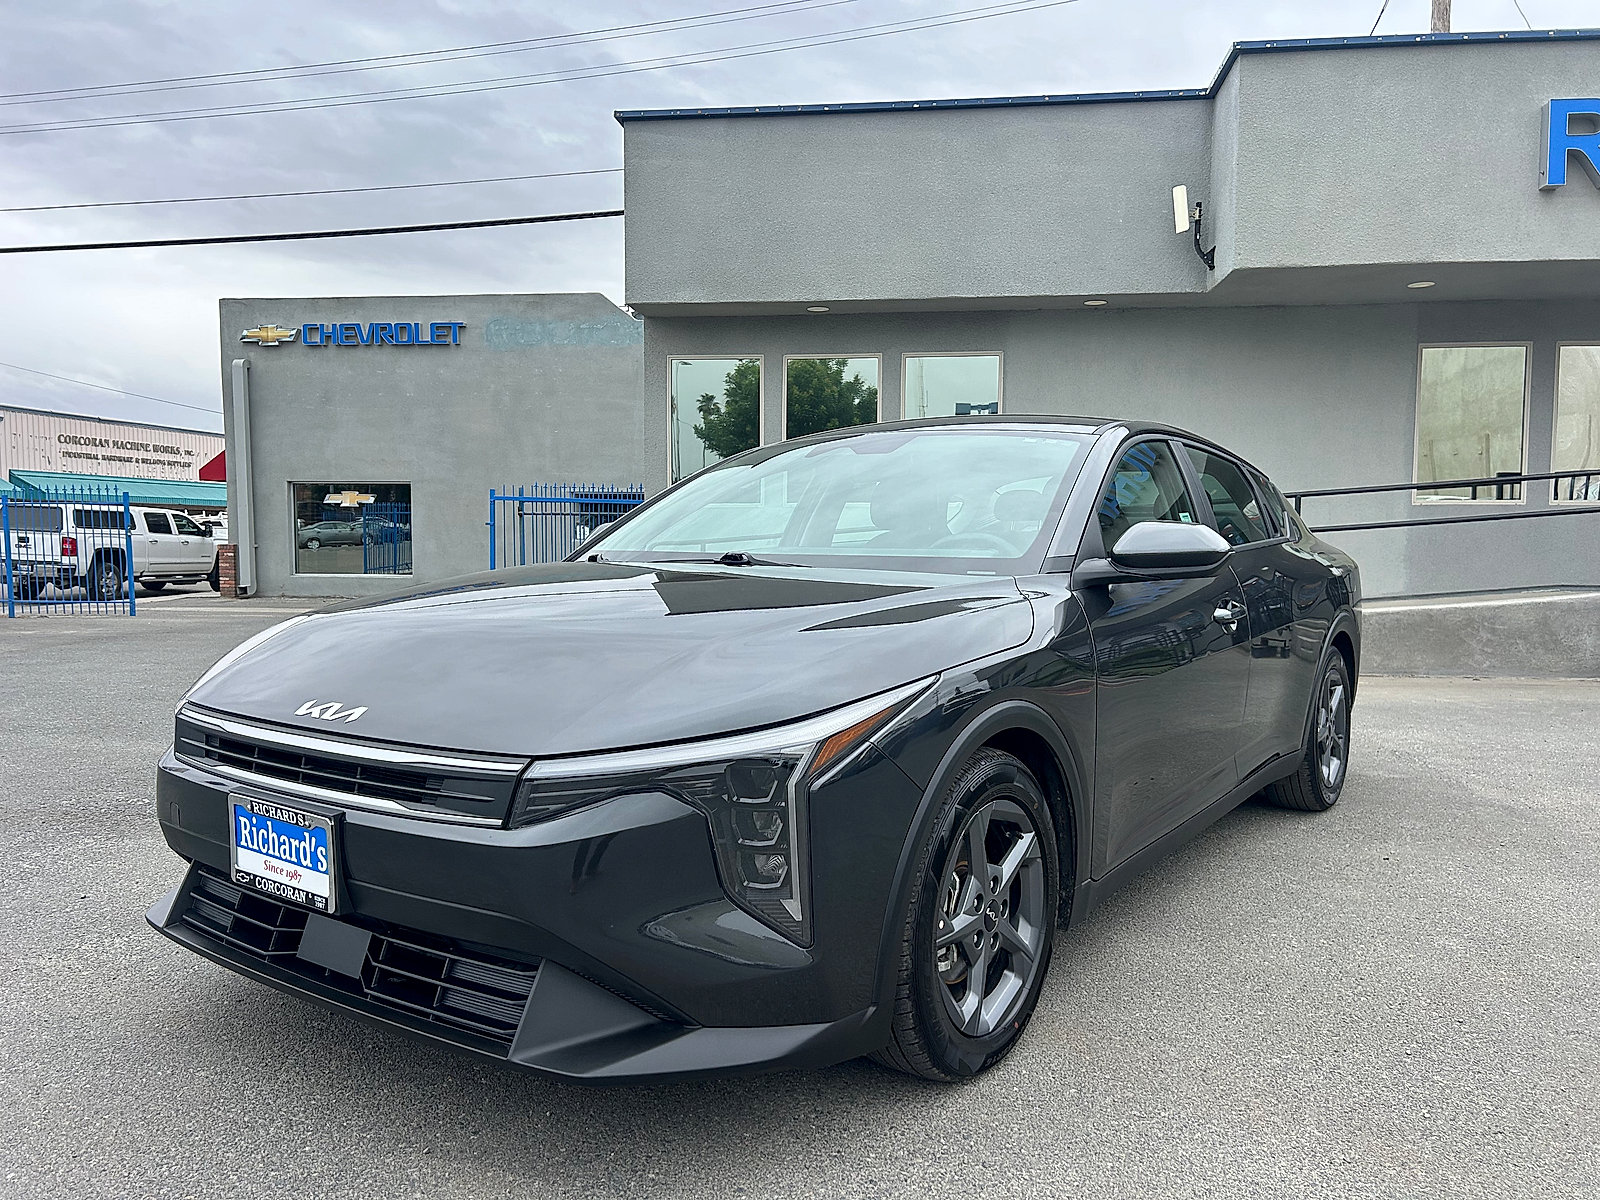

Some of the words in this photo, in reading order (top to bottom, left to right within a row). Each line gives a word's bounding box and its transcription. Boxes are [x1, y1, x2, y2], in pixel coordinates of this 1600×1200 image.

[302, 322, 466, 345] CHEVROLET
[57, 434, 110, 448] CORCORAN
[112, 440, 151, 453] MACHINE
[153, 444, 183, 456] WORKS,
[62, 450, 100, 461] INDUSTRIAL
[141, 458, 166, 467] WELDING
[166, 459, 193, 469] SUPPLIES
[293, 698, 369, 725] KIA
[238, 815, 328, 873] Richard's
[263, 859, 284, 876] Since
[285, 869, 303, 884] 1987
[255, 876, 307, 904] CORCORAN
